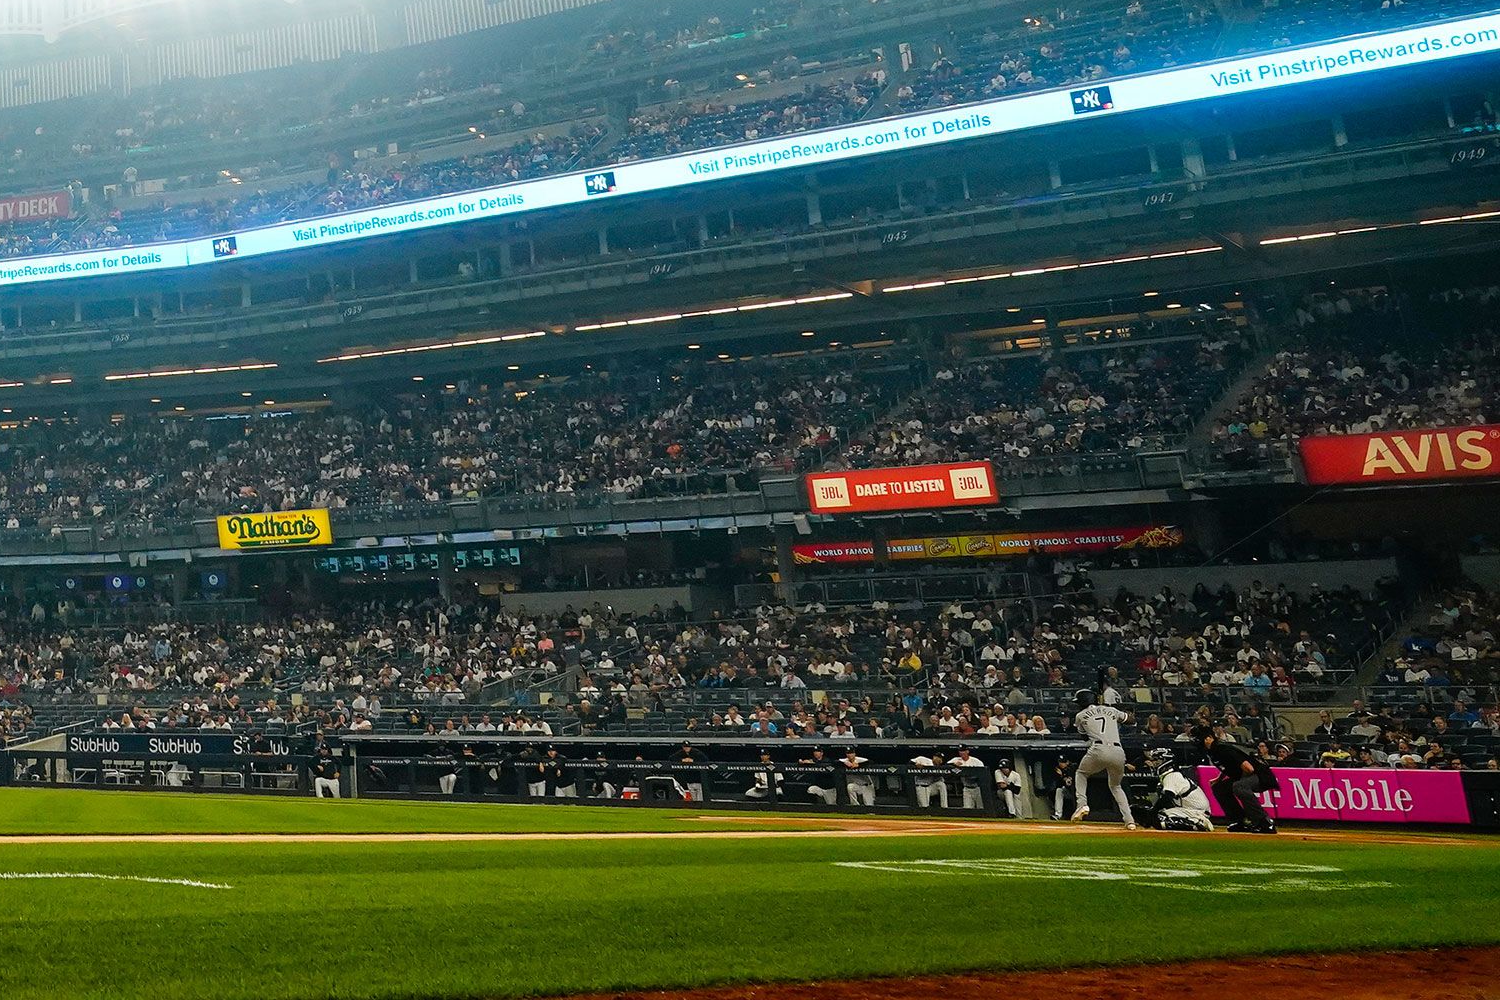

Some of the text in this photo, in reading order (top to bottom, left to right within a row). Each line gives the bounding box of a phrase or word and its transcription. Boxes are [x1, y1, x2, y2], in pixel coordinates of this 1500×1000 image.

[1210, 27, 1498, 88] Visit PinstripeRewards.com
[689, 112, 991, 176] Visit PinstripeRewards.com for Details
[1451, 148, 1485, 163] 1949
[18, 196, 59, 218] DECK
[293, 193, 524, 241] Visit PinstripeRewards.com for Details
[102, 257, 119, 268] for
[122, 252, 162, 266] Details
[855, 478, 945, 497] DARE TO LISTEN
[961, 475, 983, 491] JBL
[822, 485, 844, 500] JBL
[226, 513, 320, 539] Nathan's
[813, 549, 843, 557] WORLD
[845, 547, 874, 556] FAMOU
[999, 539, 1031, 548] WORLD
[1094, 716, 1106, 733] 7
[70, 736, 120, 753] StubHub
[149, 738, 202, 754] StubHub
[1288, 777, 1414, 812] Mobile
